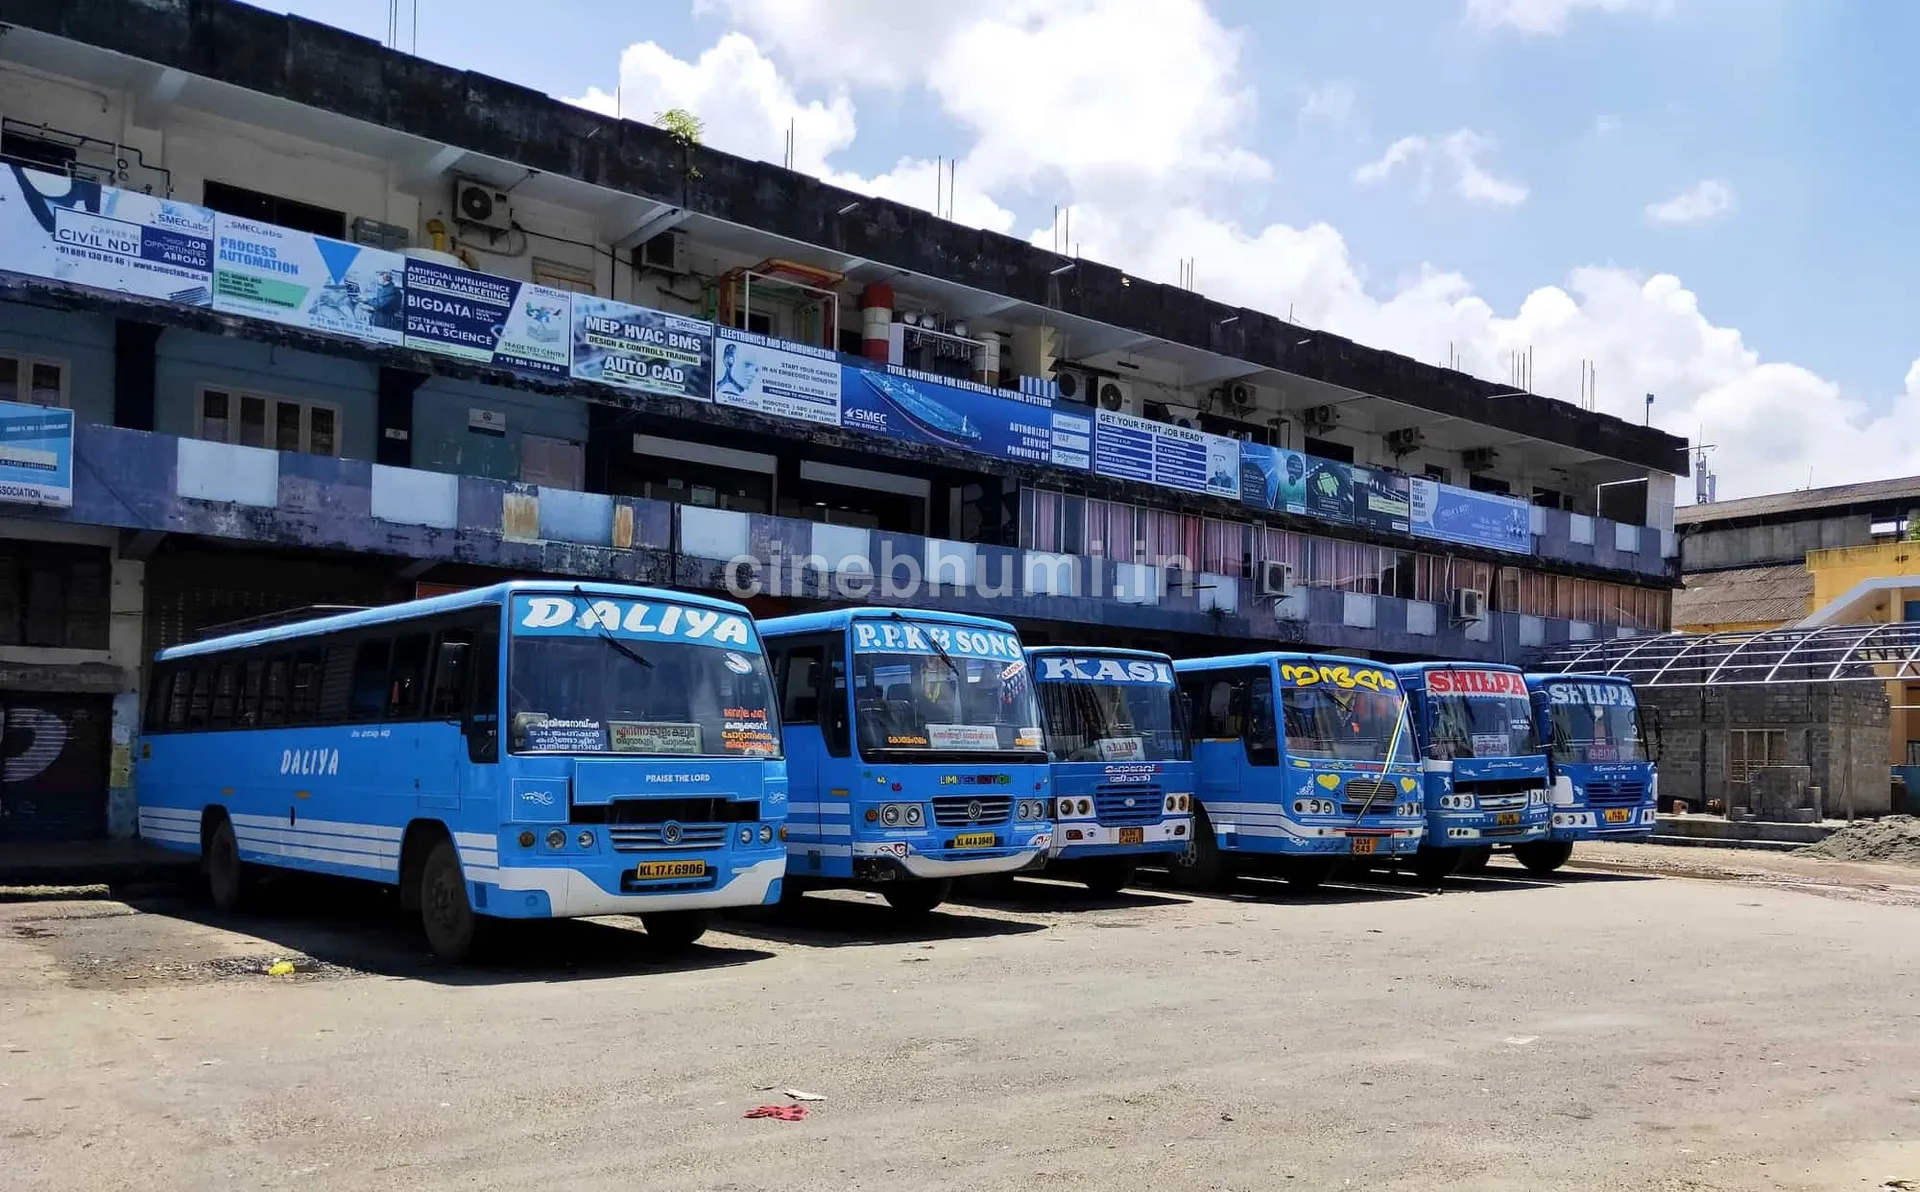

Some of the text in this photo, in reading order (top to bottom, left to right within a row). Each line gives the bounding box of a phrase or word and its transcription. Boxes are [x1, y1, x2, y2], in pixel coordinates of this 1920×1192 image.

[59, 228, 139, 254] CIVIL NDT
[144, 239, 207, 259] OPPORTUNITIES
[187, 239, 207, 251] JOB
[220, 236, 277, 259] PROCESS
[163, 252, 206, 266] ABROAD
[219, 250, 299, 275] AUTOMATION
[407, 273, 449, 289] DIGITAL
[450, 283, 510, 301] MARKETING
[408, 266, 511, 293] ARTIFICIAL INTELLIGENCE
[408, 295, 472, 318] BIGDATA
[408, 322, 440, 335] DATA
[443, 327, 493, 346] SCIENCE
[585, 315, 701, 351] MEP HVAC BMS
[721, 327, 837, 361] ELECTRONICS AND COMMUNICATION
[589, 336, 617, 348] DESIGN
[626, 342, 664, 357] CONTROLS
[665, 350, 699, 364] TRAINING
[604, 356, 684, 382] AUTO CAD
[887, 364, 906, 378] TOTAL
[907, 367, 943, 385] SOLUTIONS
[944, 375, 956, 386] FOR
[957, 378, 992, 396] ELECTRICAL
[998, 388, 1025, 403] CONTROL
[1025, 394, 1052, 408] SYSTEMS
[844, 419, 887, 433] www.smec.in
[855, 409, 887, 424] SMEC
[1100, 413, 1115, 424] GET
[1117, 417, 1139, 429] YOUR
[1140, 422, 1162, 434] FIRST
[1163, 428, 1178, 437] JOB
[1180, 430, 1205, 443] READY
[1009, 421, 1050, 439] AUTHORIZED
[1007, 445, 1050, 462] PROVIDER OF
[1022, 436, 1050, 449] SERVICE
[522, 597, 748, 645] DALIYA
[855, 622, 1023, 658] P.P.K & SONS
[1042, 658, 1171, 684] KASI
[1428, 672, 1527, 695] SHILPA
[1549, 684, 1636, 706] SHILPA
[280, 748, 339, 776] DALIYA
[645, 774, 710, 783] PRAISE THE LORD
